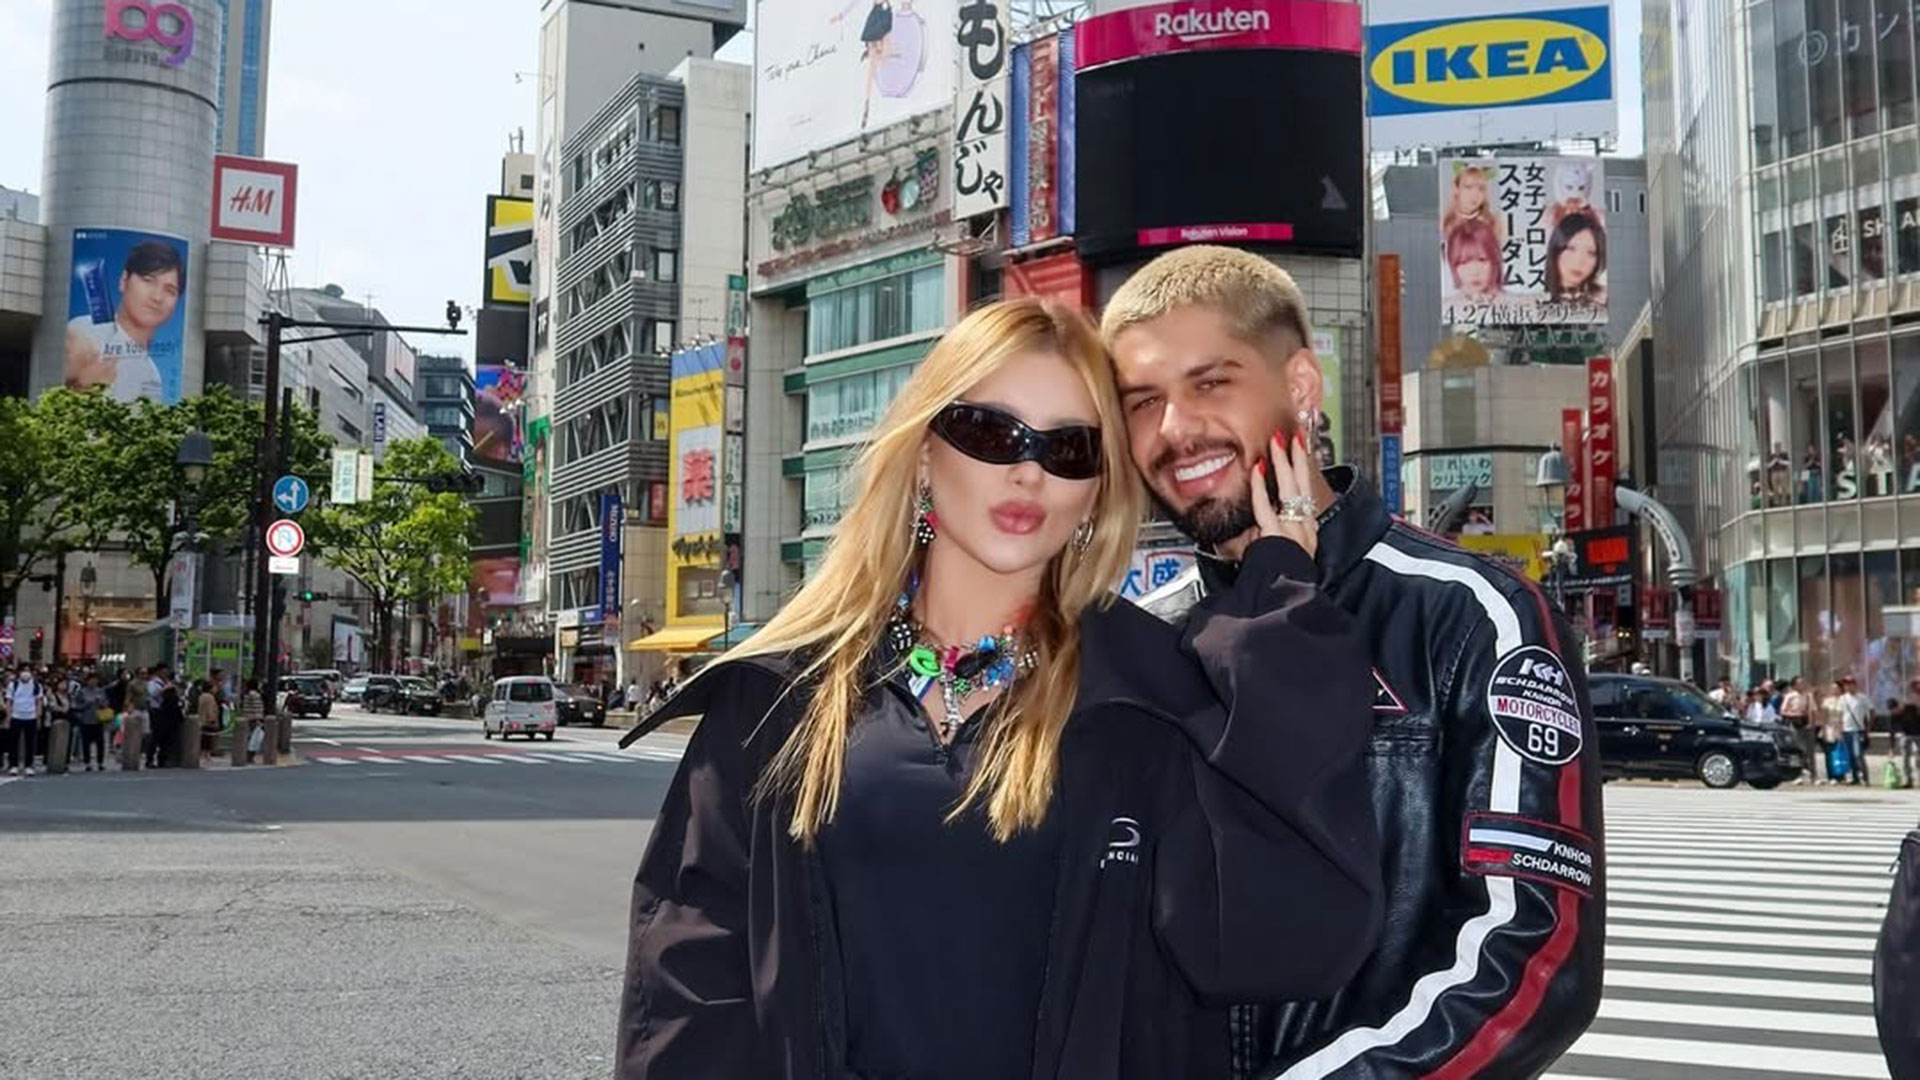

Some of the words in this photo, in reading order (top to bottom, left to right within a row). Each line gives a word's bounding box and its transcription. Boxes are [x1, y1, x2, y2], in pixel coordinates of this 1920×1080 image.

[1155, 7, 1270, 37] Rakuten
[1392, 37, 1590, 85] IKEA
[956, 2, 1004, 205] もんじゃ
[230, 185, 275, 216] H&M
[1181, 227, 1218, 241] Rakuten
[1219, 225, 1249, 237] Vision
[1498, 164, 1525, 286] スターダム
[1523, 162, 1547, 289] 女子プロレス
[1497, 697, 1580, 736] MOTORCYCLES
[1527, 722, 1559, 757] 69
[1511, 852, 1593, 887] SCHDARROW
